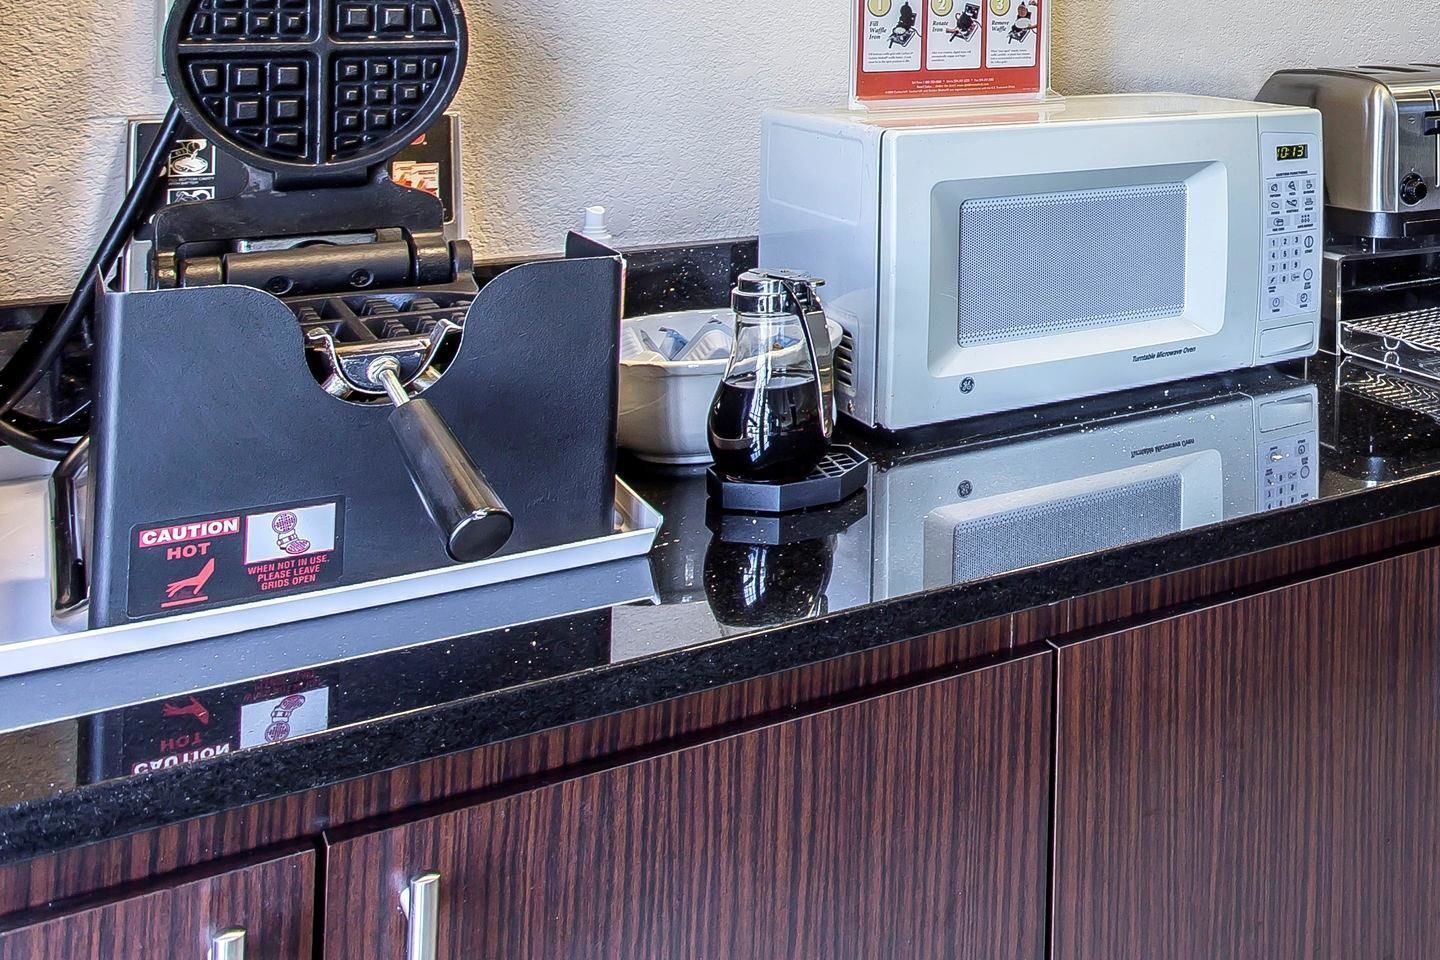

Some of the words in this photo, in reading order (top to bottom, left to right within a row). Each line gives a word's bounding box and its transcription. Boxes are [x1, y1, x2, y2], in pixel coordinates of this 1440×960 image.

[1132, 353, 1156, 362] Turntable
[1156, 349, 1182, 358] Microwave
[1183, 346, 1196, 354] Oven
[142, 519, 238, 545] CAUTION
[166, 542, 211, 561] HOT
[248, 563, 275, 575] WHEN
[277, 560, 296, 571] NOT
[298, 557, 308, 567] IN
[257, 570, 292, 582] PLEASE
[293, 564, 321, 576] LEAVE
[261, 578, 290, 590] GRIDS
[292, 573, 316, 586] OPEN
